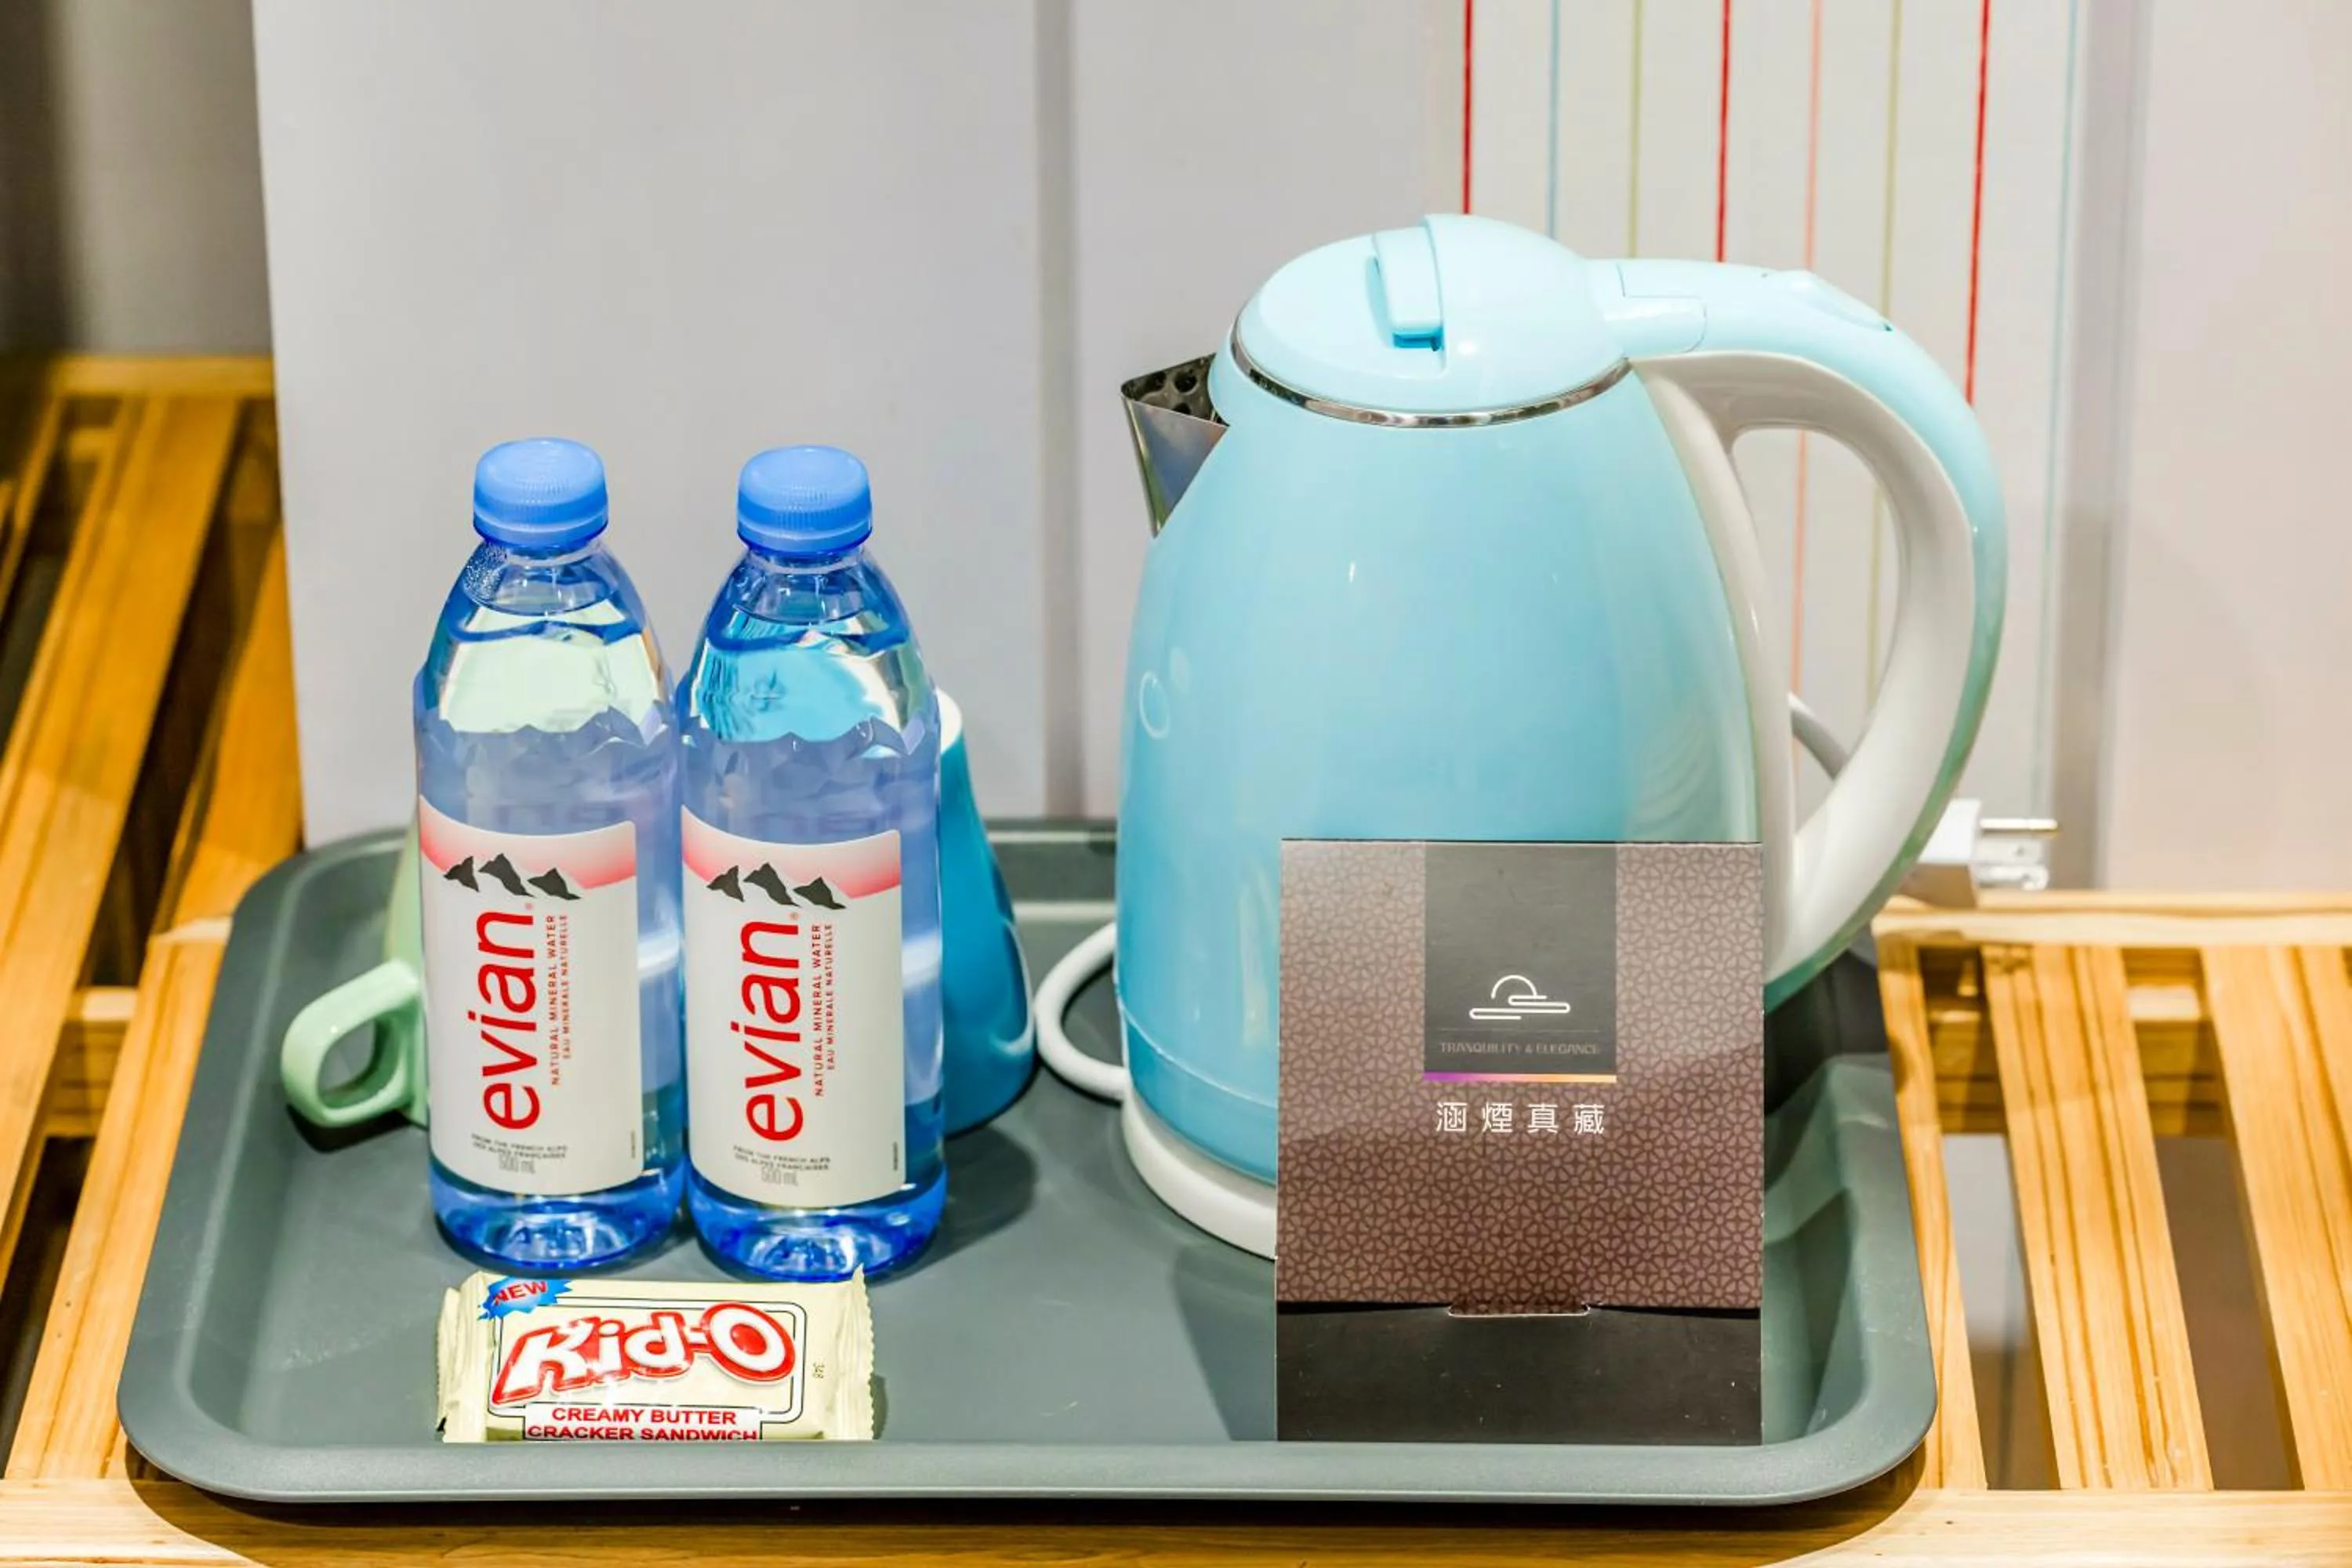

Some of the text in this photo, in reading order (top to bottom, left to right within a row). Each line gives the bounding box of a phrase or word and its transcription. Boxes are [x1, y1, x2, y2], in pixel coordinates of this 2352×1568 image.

[559, 915, 568, 976] NATURELLE
[824, 924, 833, 985] NATURELLE
[468, 911, 539, 1130] evian
[546, 915, 559, 1085] NATURAL MINERAL WATER
[811, 925, 823, 1097] NATURAL MINERAL WATER
[562, 1040, 571, 1059] EAU
[731, 921, 803, 1141] evian
[1536, 1043, 1600, 1055] ELEGANCE
[826, 1051, 835, 1070] EAU
[1436, 1101, 1605, 1135] 涵煙真藏
[493, 1280, 547, 1306] NEW
[492, 1301, 796, 1404] Kid-O
[527, 1425, 758, 1440] CRACKER SANDWICH
[551, 1406, 737, 1425] CREAMY BUTTER
